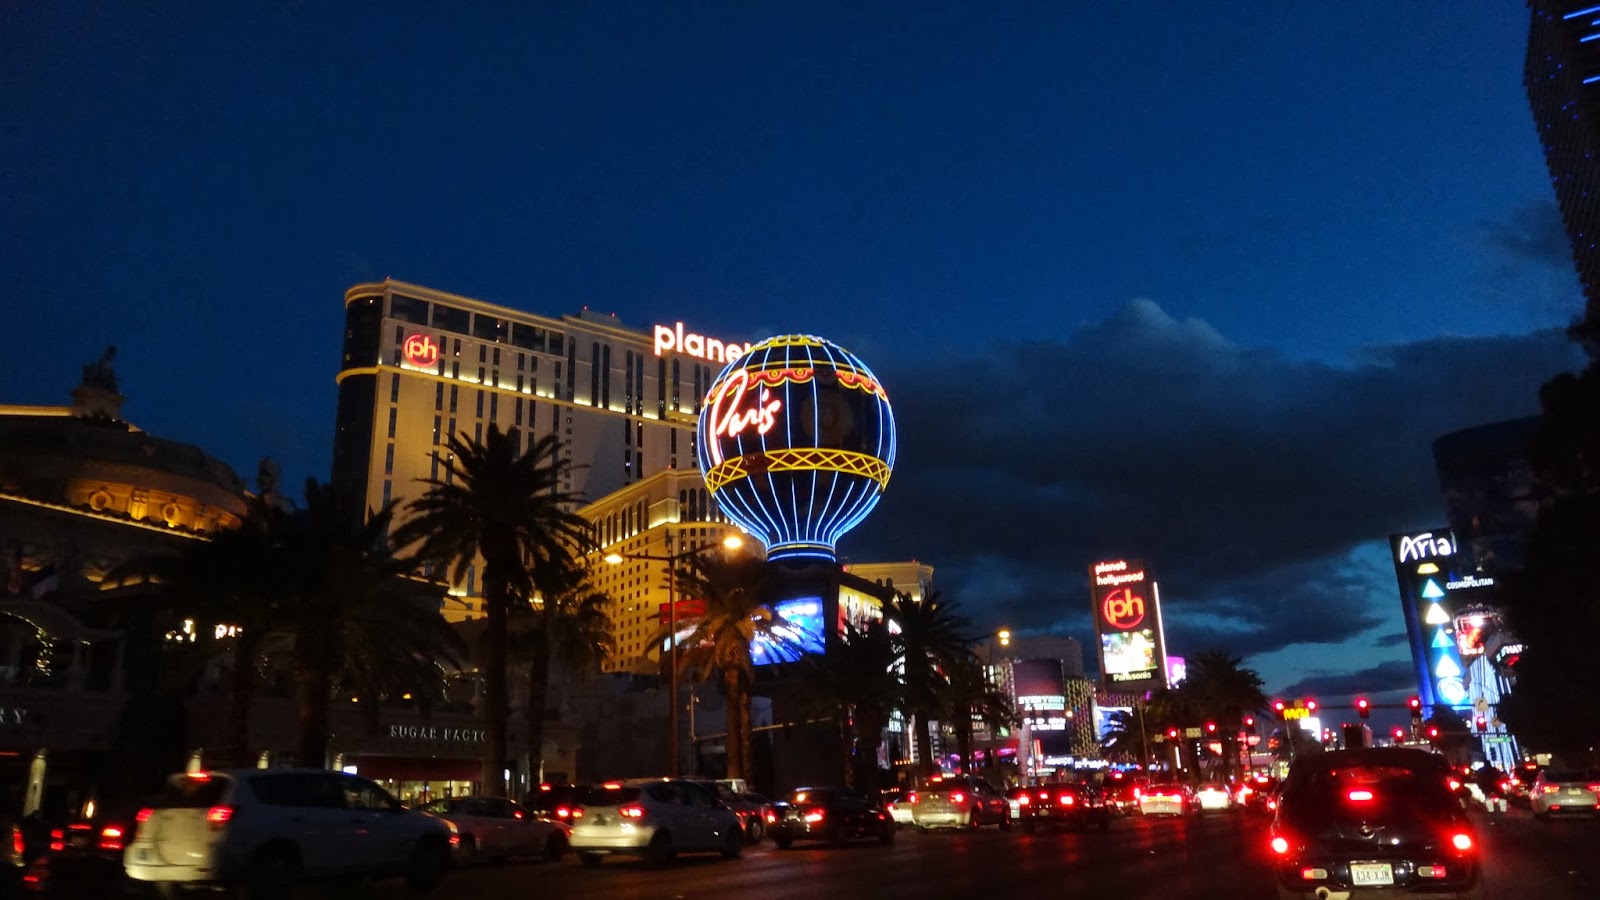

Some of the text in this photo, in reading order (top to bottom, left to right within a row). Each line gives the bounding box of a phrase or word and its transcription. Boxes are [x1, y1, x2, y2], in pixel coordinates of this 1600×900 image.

[407, 336, 437, 362] ph
[654, 321, 752, 364] plane
[709, 368, 782, 466] Paris
[1400, 533, 1452, 563] Aria
[1095, 561, 1127, 575] planet
[1096, 571, 1144, 586] hollywood
[1446, 578, 1494, 590] COSMOPOLITAN
[1108, 588, 1144, 624] ph
[1112, 671, 1152, 682] Panasonic
[390, 725, 437, 739] SUGAR
